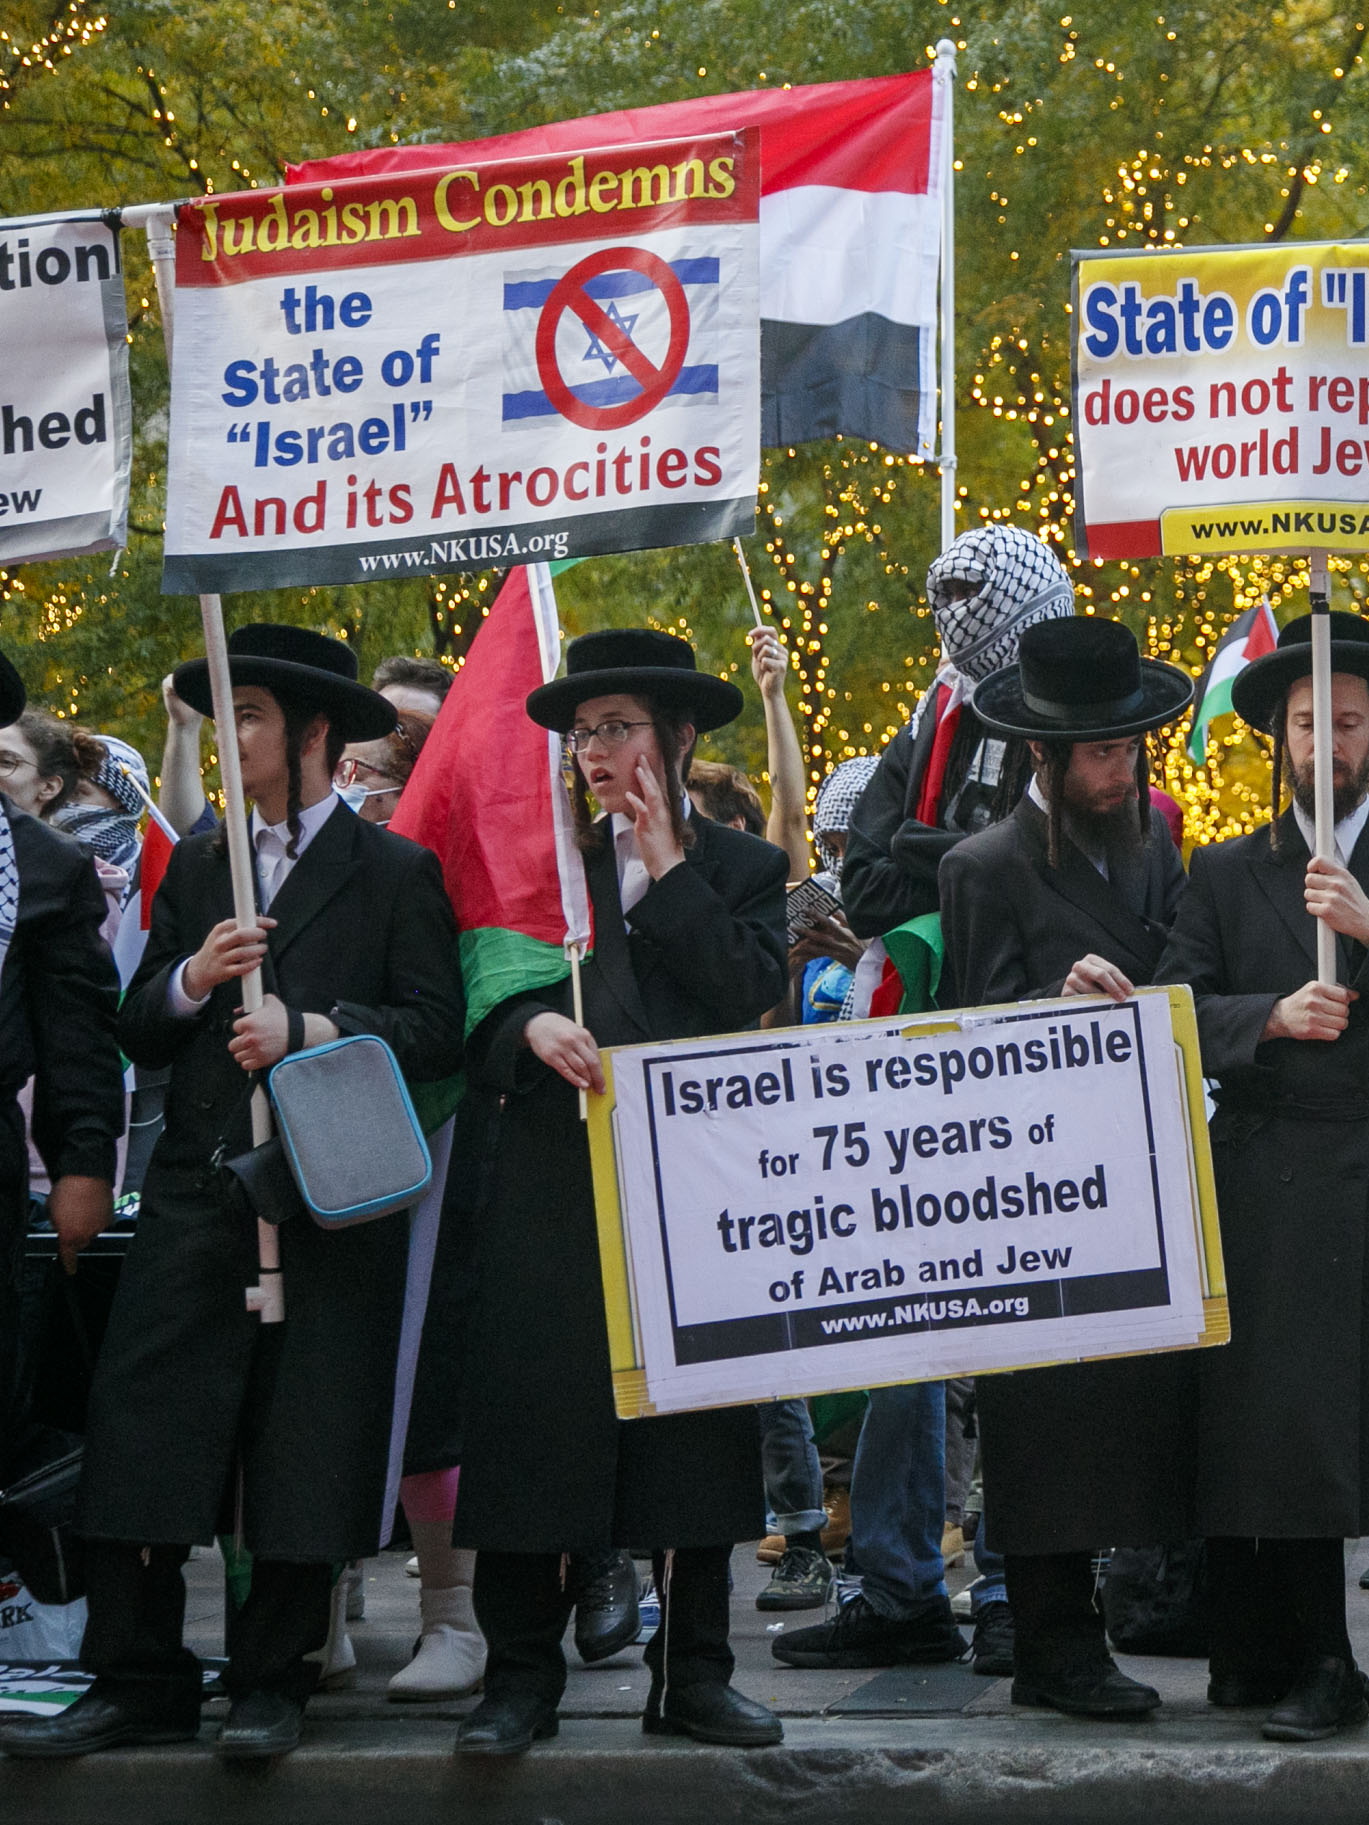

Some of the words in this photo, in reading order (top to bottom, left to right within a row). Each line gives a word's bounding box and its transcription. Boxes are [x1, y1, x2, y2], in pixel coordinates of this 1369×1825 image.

[199, 188, 422, 261] Judaism
[433, 156, 736, 232] Condemns
[280, 285, 373, 335] the
[1083, 281, 1236, 359] State
[1251, 268, 1310, 347] of
[221, 348, 364, 408] State
[380, 333, 441, 387] of
[1084, 379, 1196, 426] does
[1208, 366, 1294, 419] not
[1174, 426, 1299, 482] world
[209, 480, 327, 539] And
[346, 474, 414, 529] its
[431, 436, 722, 519] Atrocities
[359, 531, 569, 572] www.NKUSA.org
[662, 1057, 795, 1117] Israel
[810, 1054, 851, 1099] is
[865, 1022, 1133, 1094] responsible
[758, 1148, 800, 1179] for
[813, 1122, 871, 1172] 75
[884, 1115, 1013, 1175] years
[1027, 1113, 1056, 1147] of
[716, 1197, 857, 1255] tragic
[871, 1164, 1109, 1232] bloodshed
[768, 1269, 805, 1303] of
[818, 1258, 906, 1298] Arab
[919, 1248, 984, 1283] and
[996, 1245, 1074, 1275] Jew
[821, 1294, 1030, 1335] www.NKUSA.org
